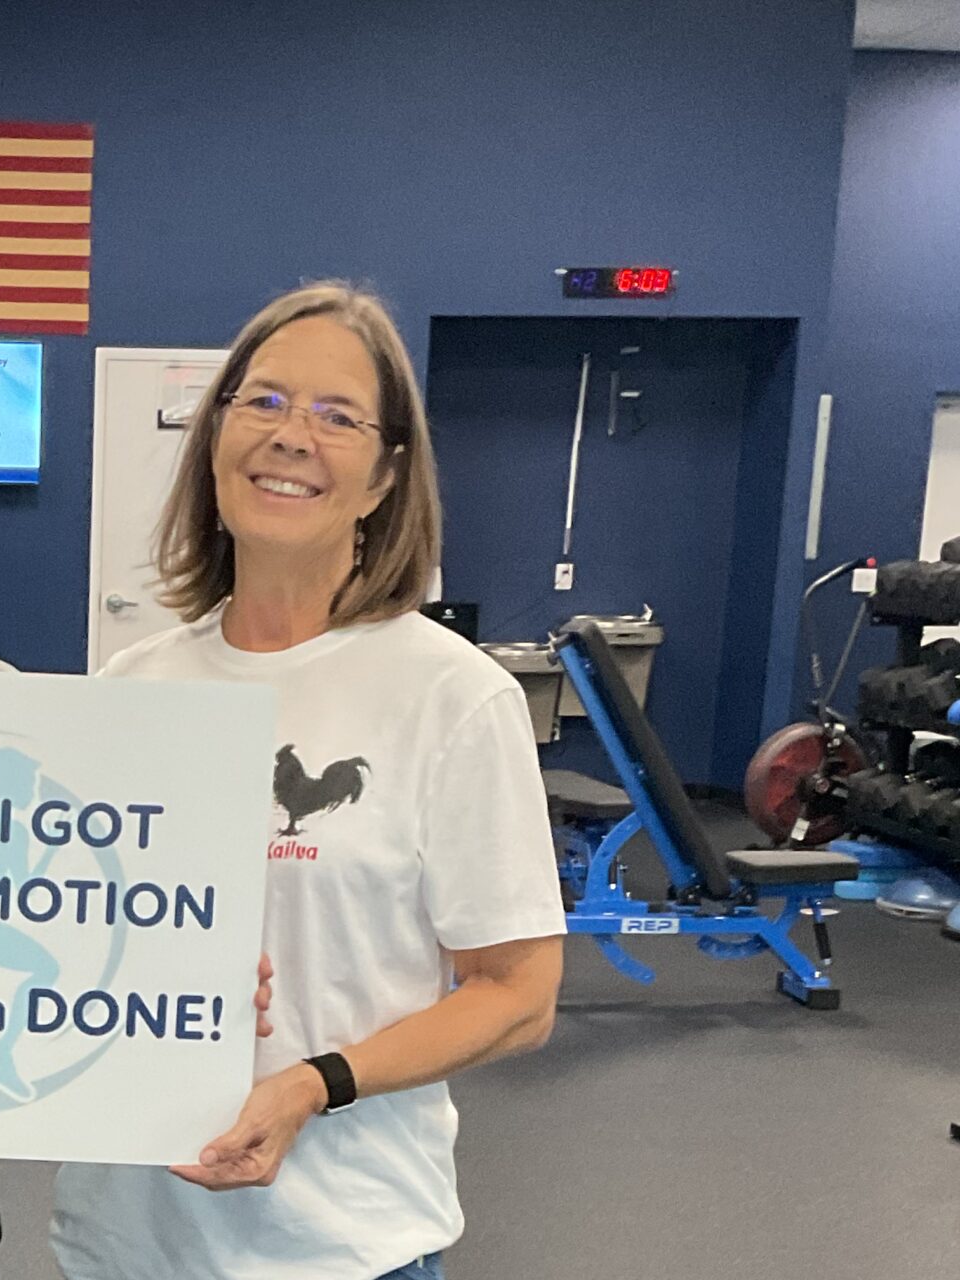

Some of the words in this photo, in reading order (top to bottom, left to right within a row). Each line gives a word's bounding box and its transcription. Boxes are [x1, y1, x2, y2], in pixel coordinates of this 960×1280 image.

[618, 268, 671, 292] 6:03
[0, 798, 12, 844] I
[32, 800, 164, 849] GOT
[627, 920, 672, 931] REP
[27, 988, 224, 1042] DONE!
